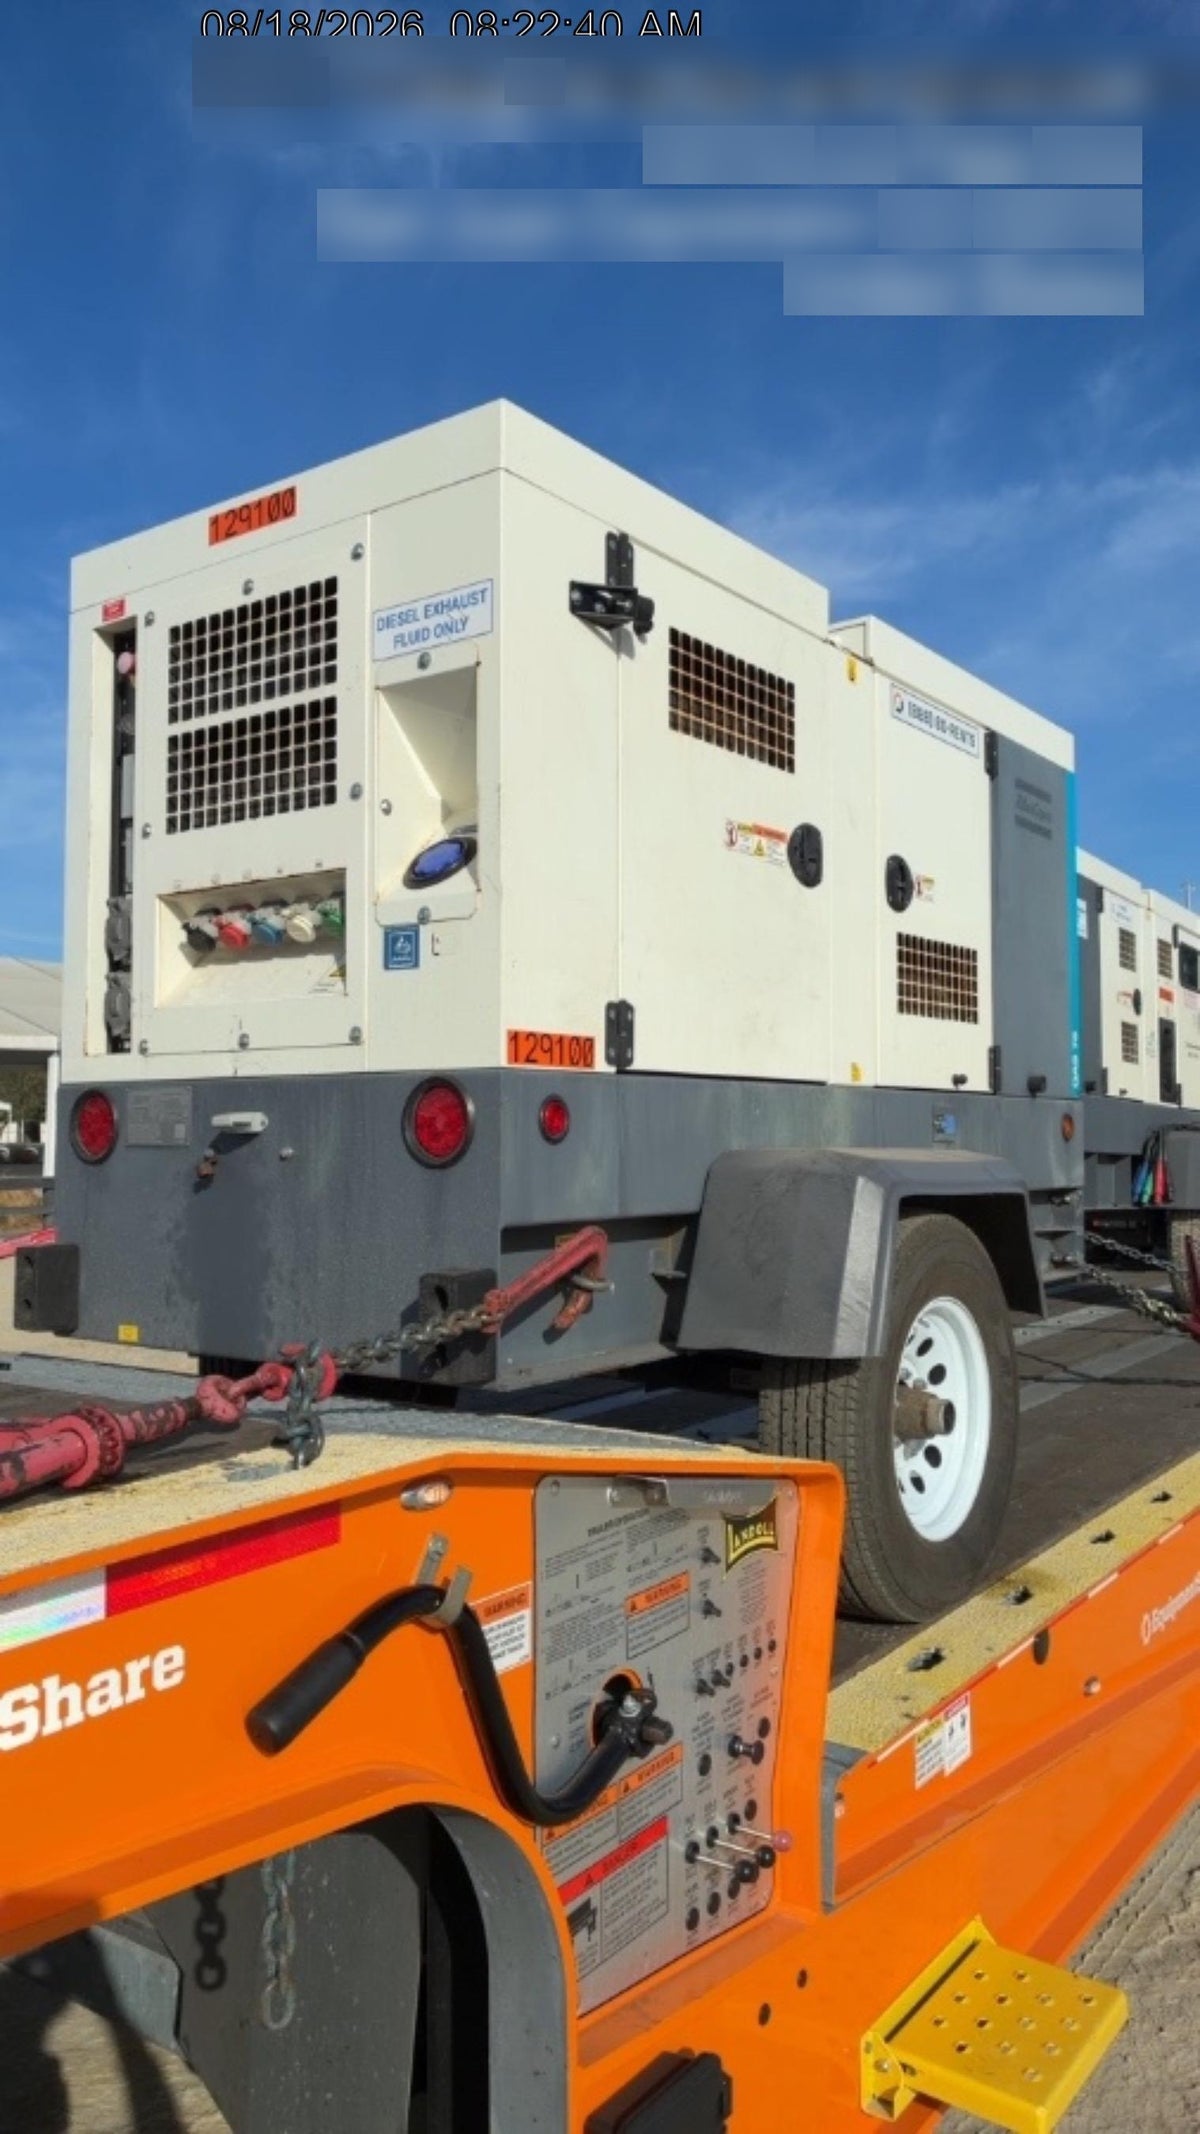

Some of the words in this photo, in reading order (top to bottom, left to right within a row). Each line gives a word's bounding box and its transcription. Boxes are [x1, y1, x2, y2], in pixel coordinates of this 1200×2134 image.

[209, 486, 297, 544] 129100
[376, 608, 420, 632] DIESEL
[424, 587, 489, 620] EXHAUST
[393, 627, 430, 649] FLUID
[433, 615, 470, 639] ONLY
[507, 1031, 594, 1068] 129100
[0, 1644, 187, 1752] Share
